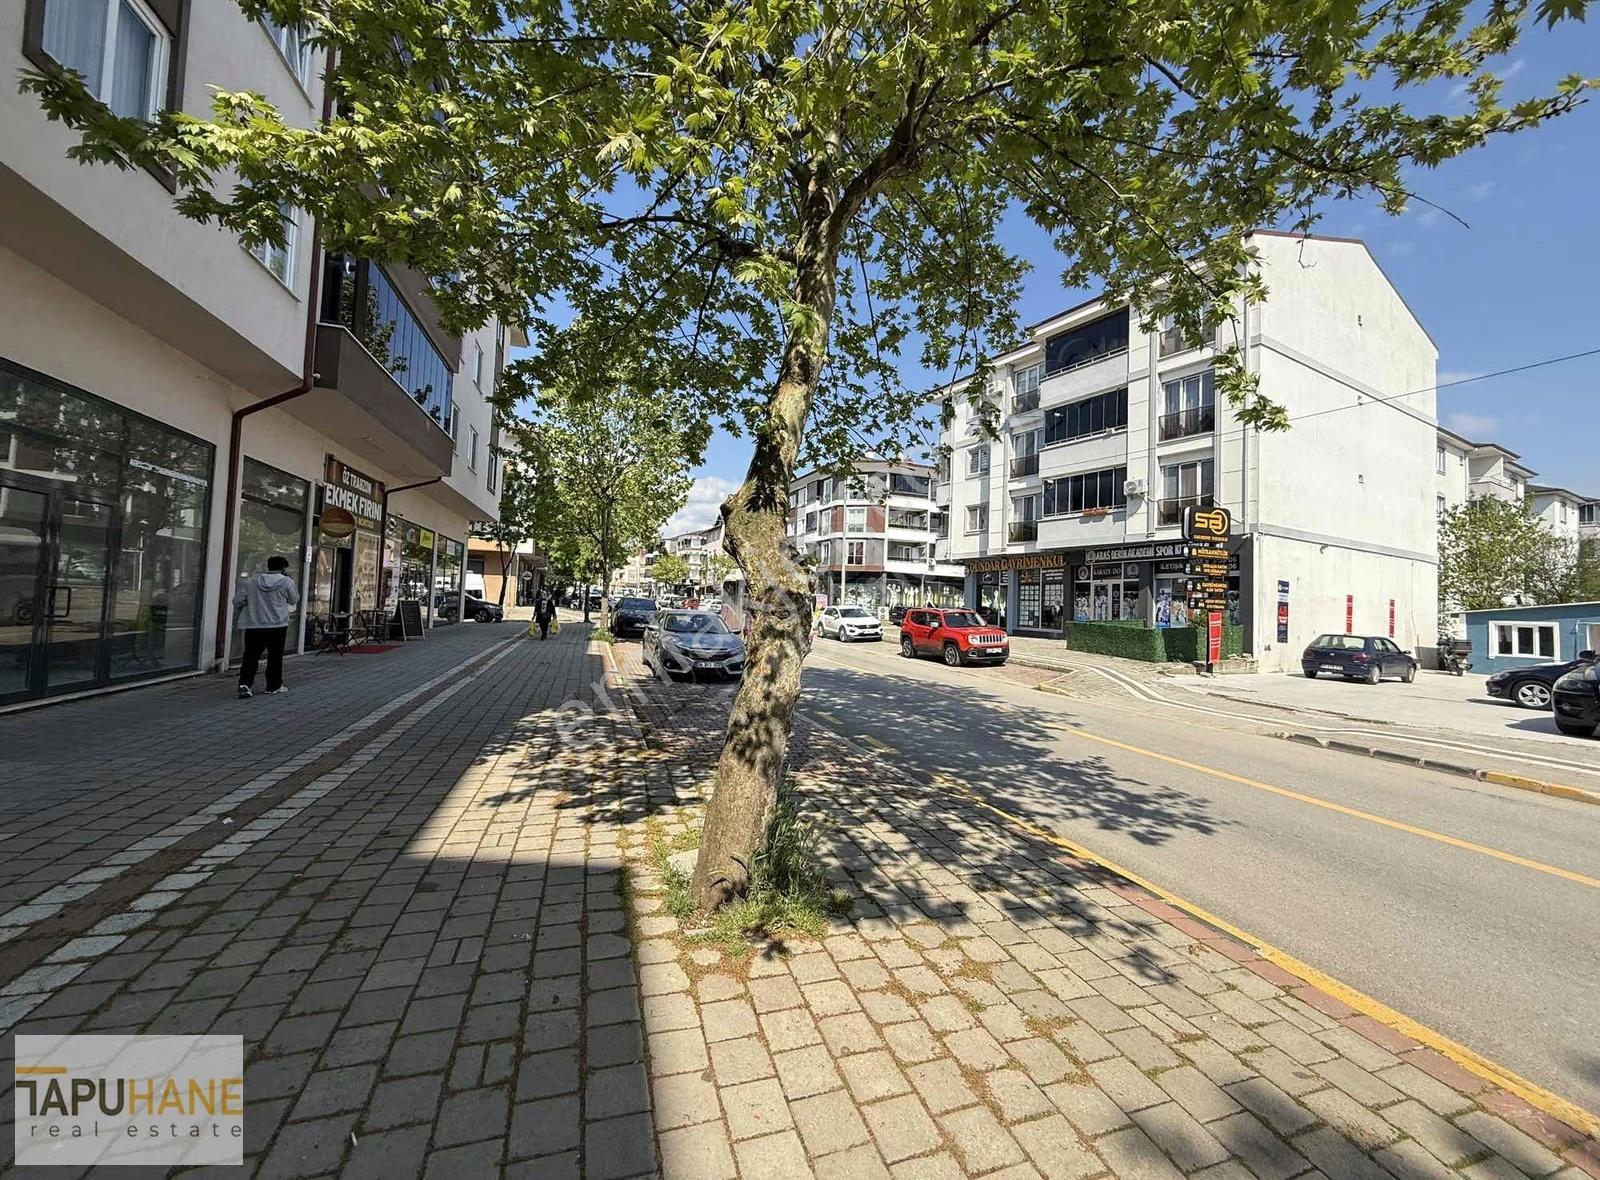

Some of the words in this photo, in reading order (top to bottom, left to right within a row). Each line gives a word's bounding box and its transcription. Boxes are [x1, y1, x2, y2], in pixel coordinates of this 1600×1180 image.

[325, 483, 359, 514] EKMEK
[359, 496, 382, 521] FIRINI
[1155, 545, 1174, 557] SPOR
